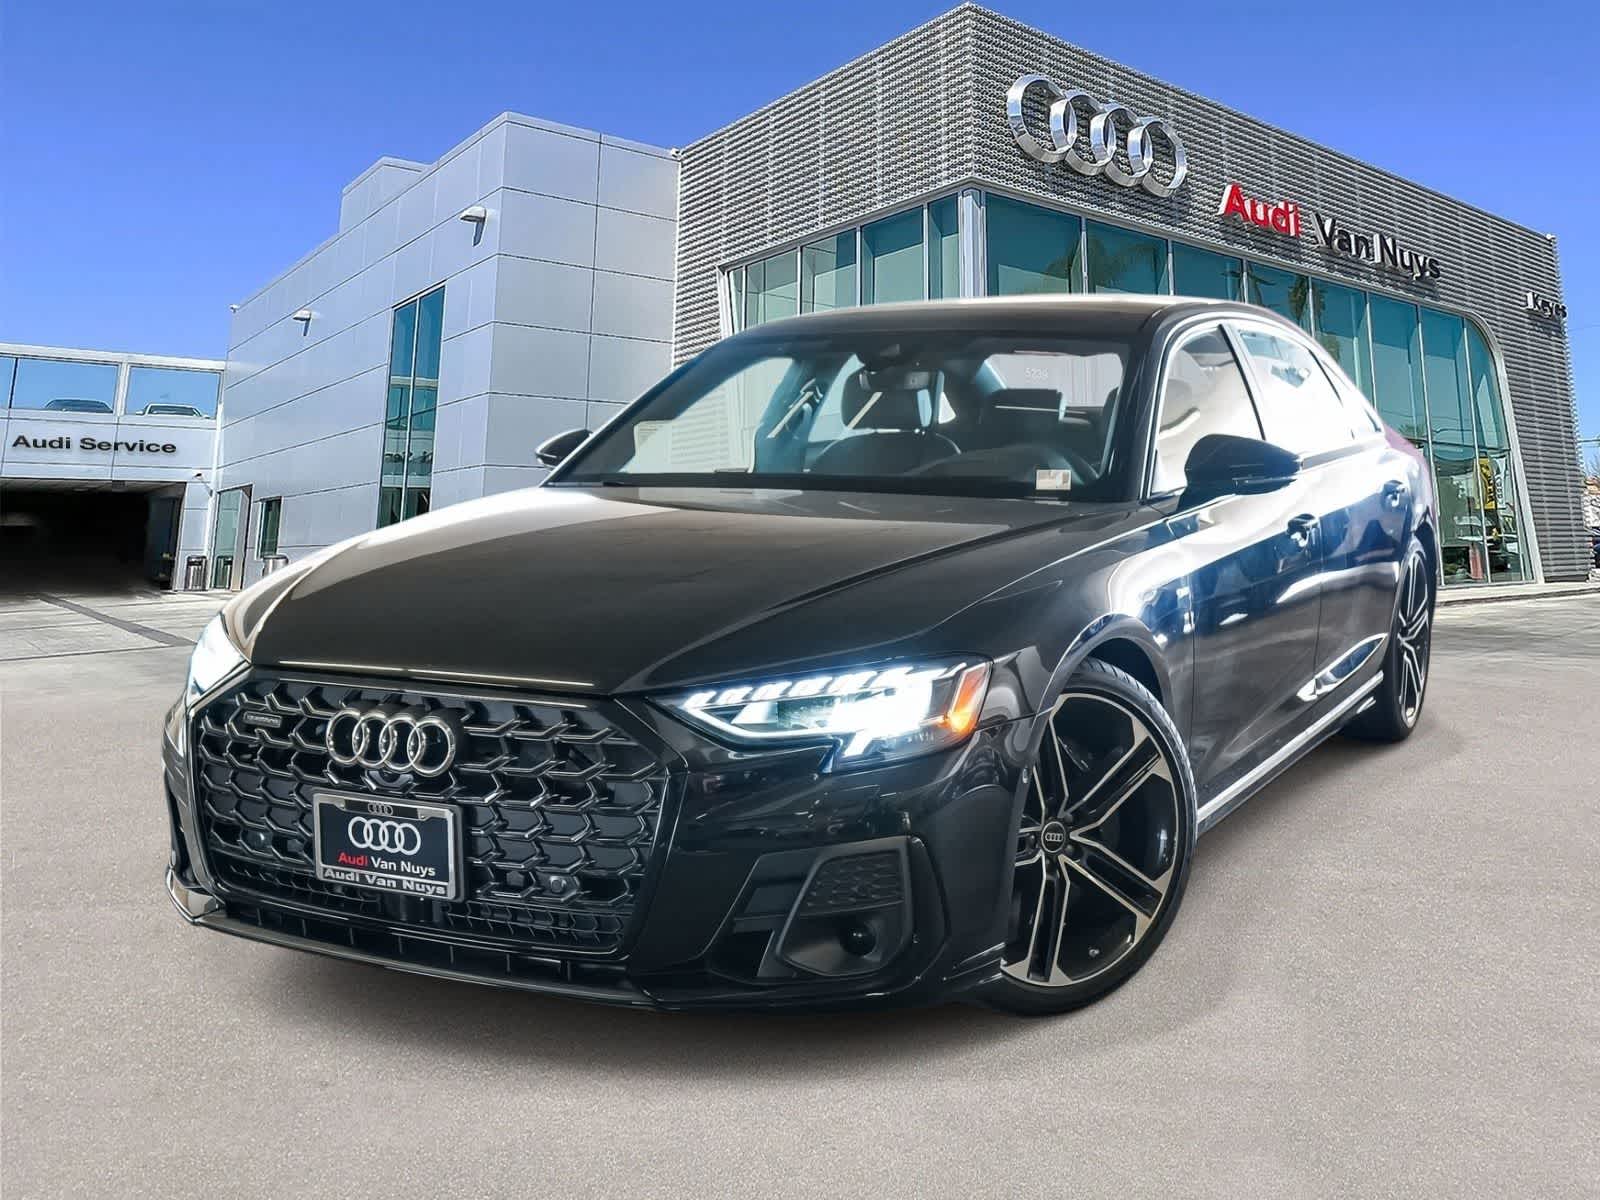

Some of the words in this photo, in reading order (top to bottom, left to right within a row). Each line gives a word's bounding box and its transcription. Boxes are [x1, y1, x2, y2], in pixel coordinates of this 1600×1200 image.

[1217, 183, 1301, 237] Audi
[1311, 212, 1370, 258] Van
[1373, 232, 1442, 281] Nuys
[12, 435, 71, 449] Audi
[79, 437, 177, 453] Service
[338, 851, 368, 866] Audi
[371, 856, 397, 871] Van
[400, 861, 436, 877] Nuys
[324, 868, 359, 882] Audi
[365, 874, 397, 888] Van
[402, 880, 446, 896] Nuys
